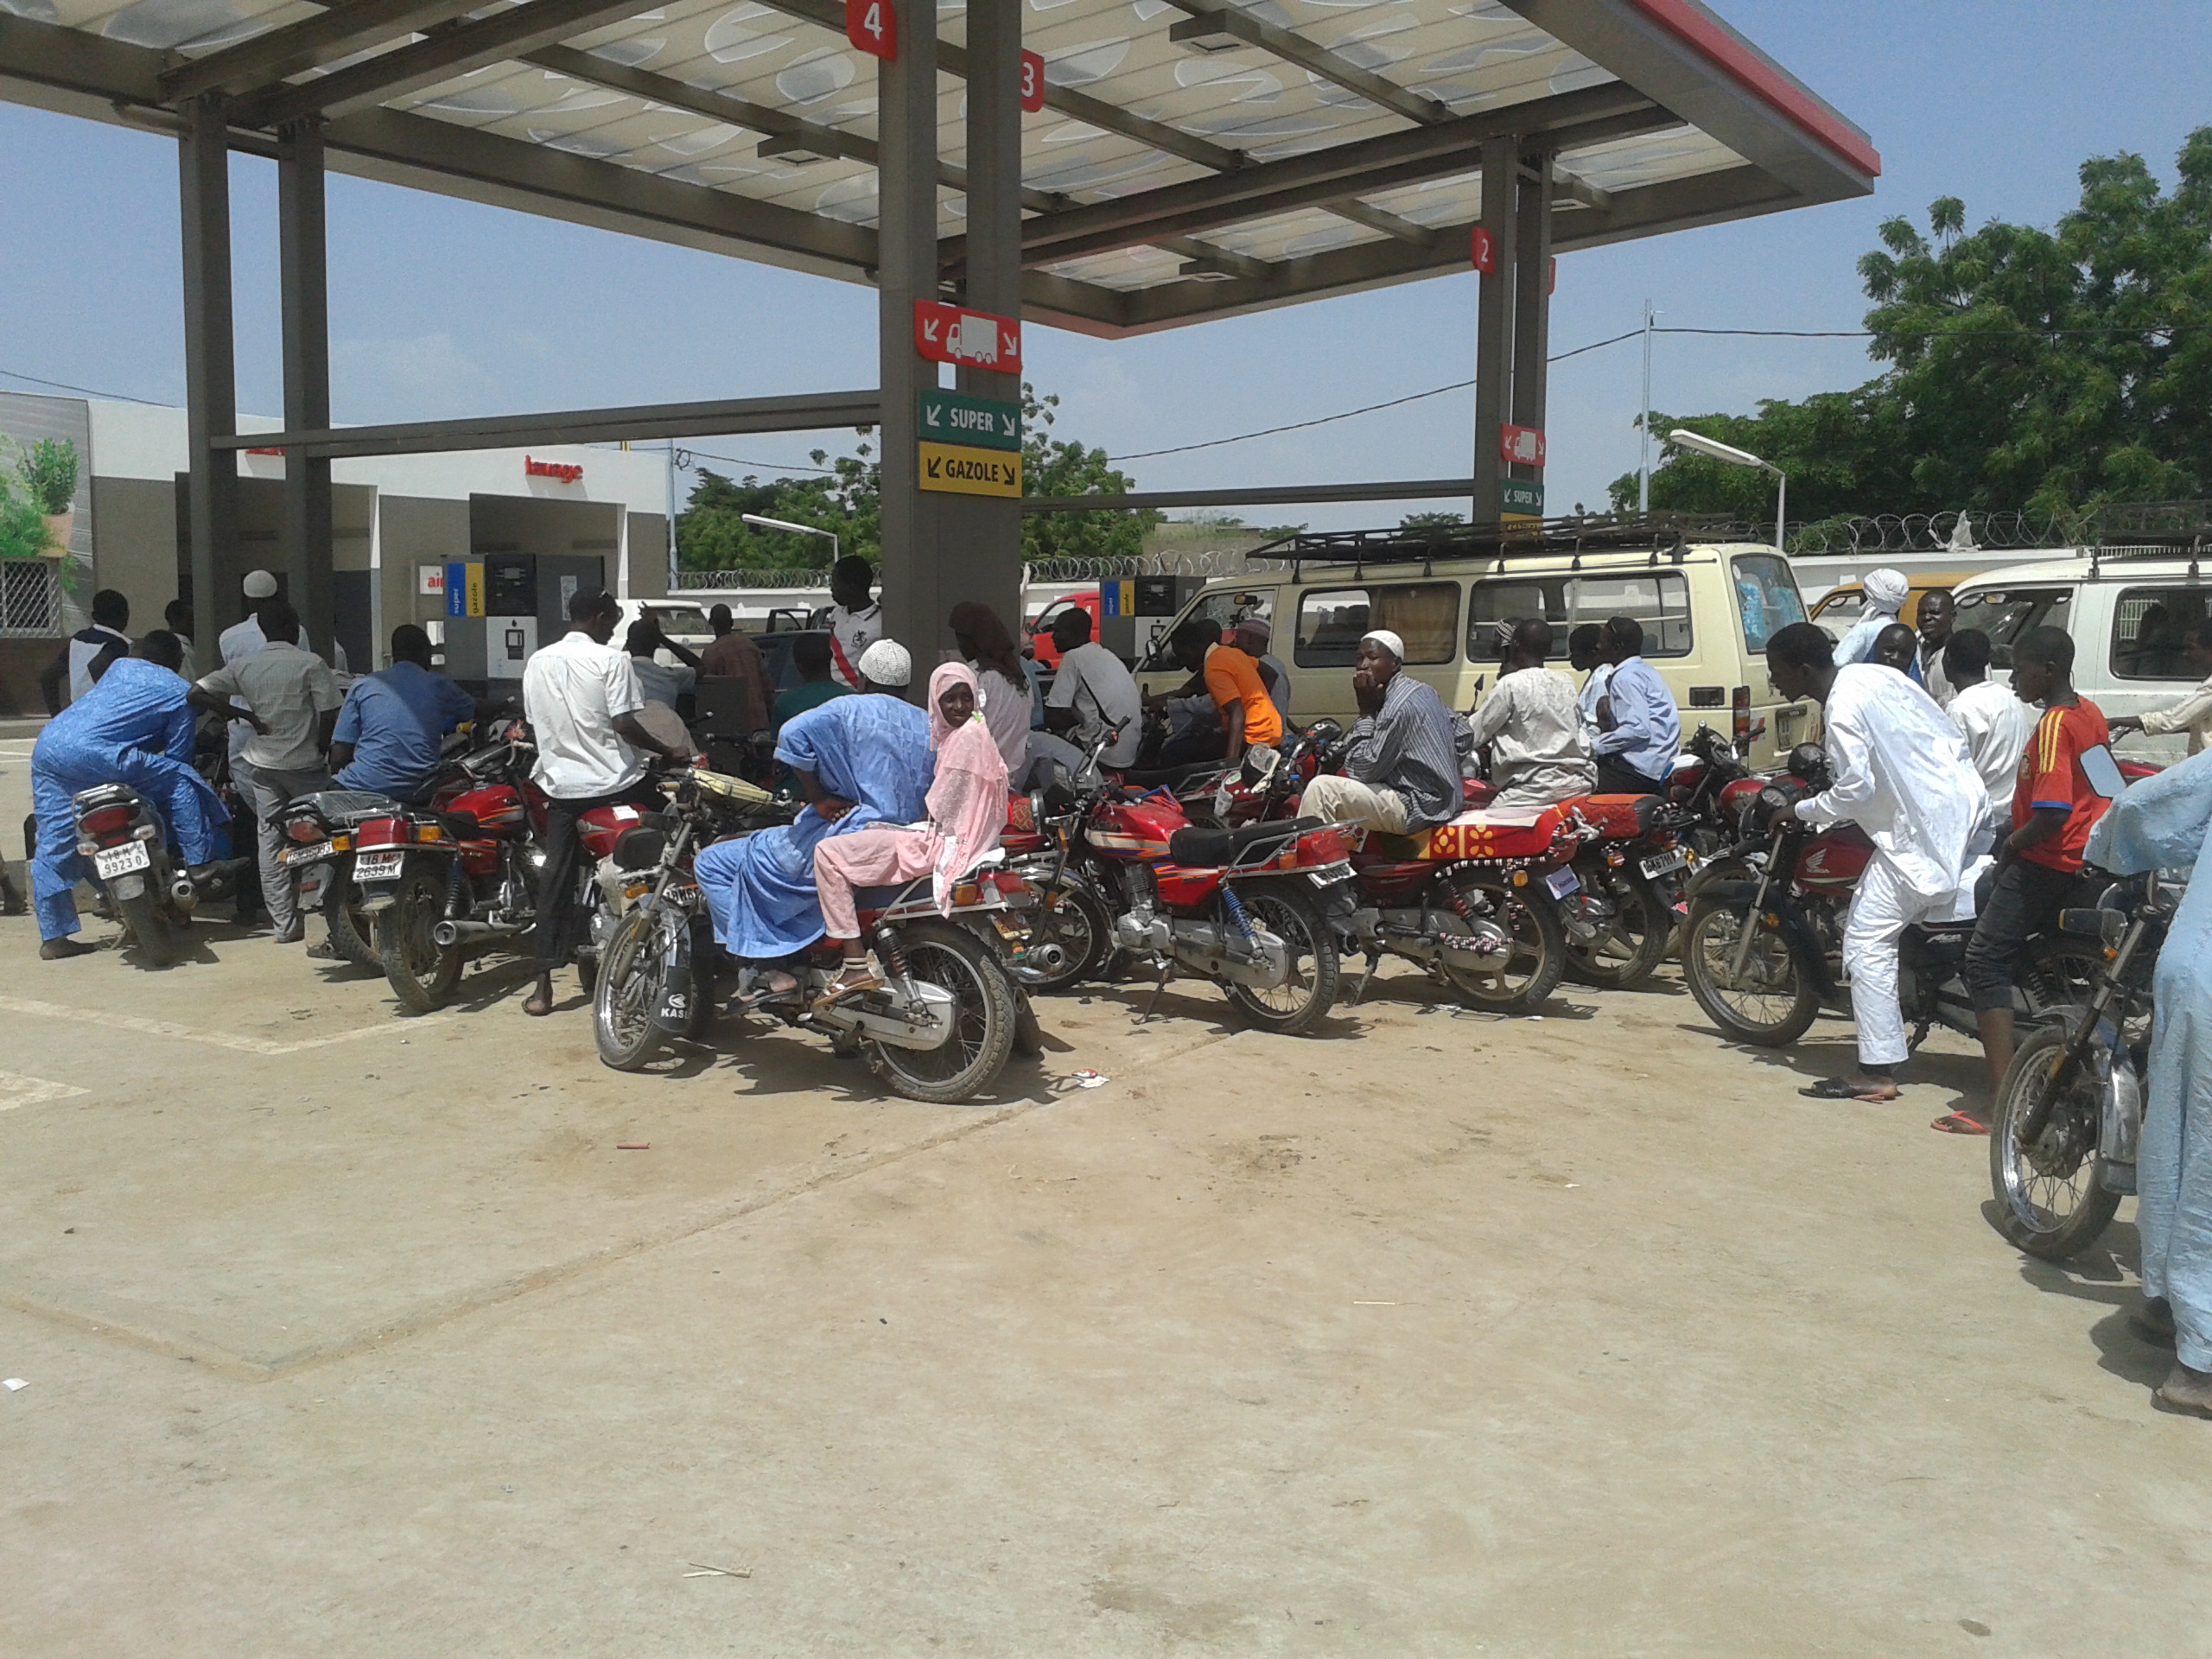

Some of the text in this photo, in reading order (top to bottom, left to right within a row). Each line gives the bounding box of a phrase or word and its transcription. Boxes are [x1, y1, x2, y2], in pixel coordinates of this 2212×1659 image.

[864, 3, 882, 40] 4
[1021, 61, 1034, 98] 3
[1481, 238, 1489, 263] 2
[950, 408, 993, 432] SUPER
[945, 459, 999, 482] GAZOLE
[1514, 490, 1533, 504] SUPER
